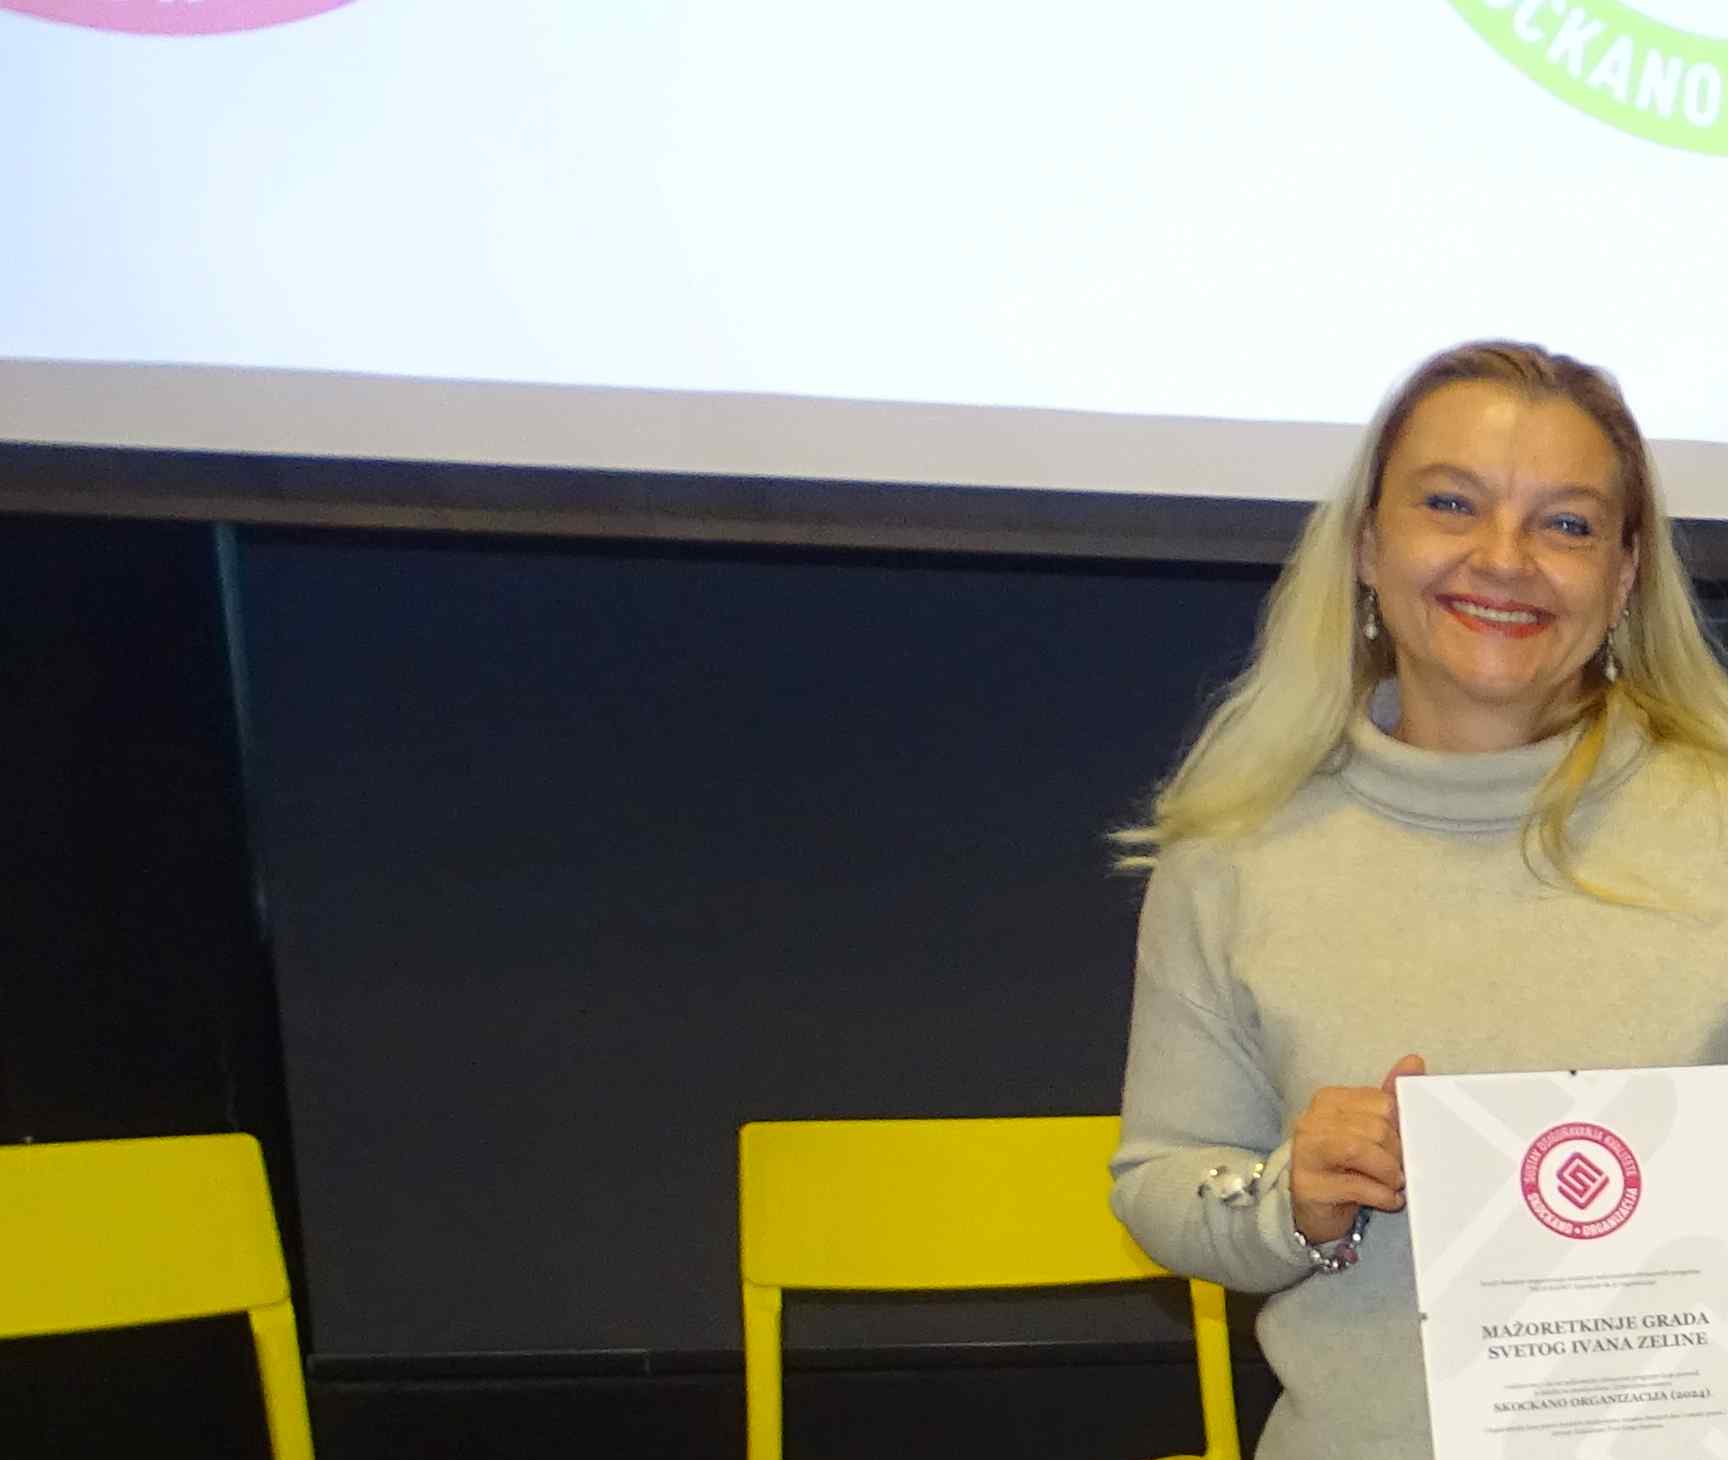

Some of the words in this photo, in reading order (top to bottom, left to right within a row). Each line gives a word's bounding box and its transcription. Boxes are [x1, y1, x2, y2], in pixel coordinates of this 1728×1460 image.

[1487, 0, 1722, 128] CKANO
[1482, 1315, 1638, 1340] MAŽORETKINJE
[1642, 1312, 1710, 1329] GRADA
[1488, 1341, 1566, 1359] SVETOG
[1572, 1336, 1633, 1354] IVANA
[1637, 1331, 1709, 1349] ZELINE
[1494, 1397, 1568, 1413] SKOCKANO
[1570, 1389, 1668, 1408] ORGANIZACIJA
